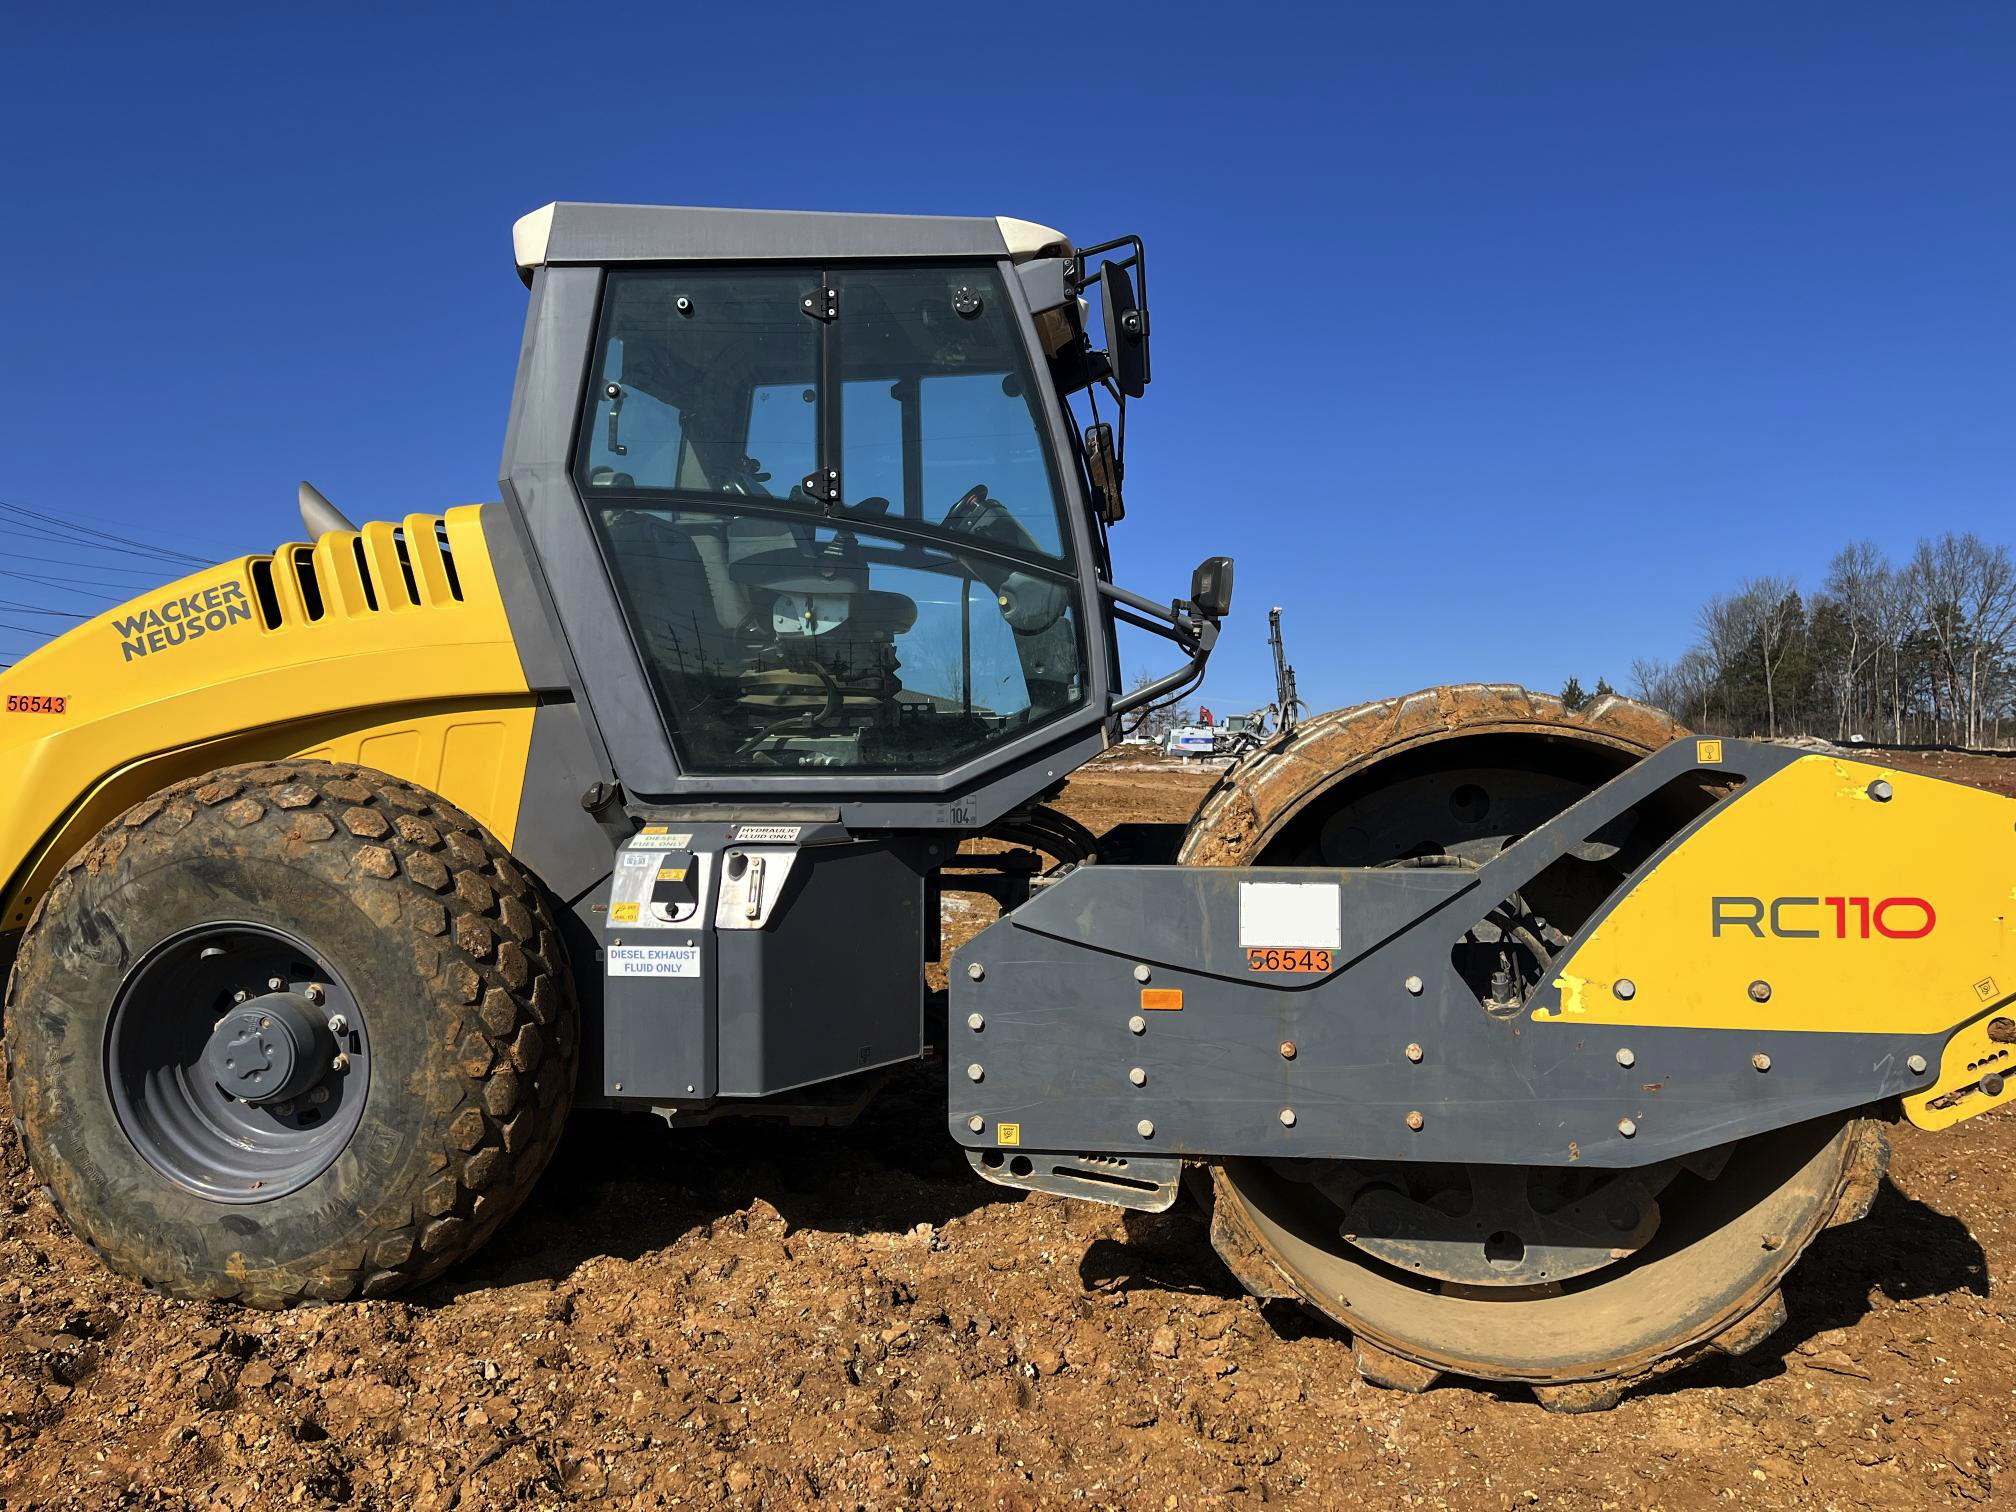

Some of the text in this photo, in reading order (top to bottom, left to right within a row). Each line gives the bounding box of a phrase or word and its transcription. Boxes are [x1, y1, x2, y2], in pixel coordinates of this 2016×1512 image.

[112, 580, 247, 639] WACKER
[120, 599, 252, 662] NEUSON
[7, 695, 65, 714] 56543
[951, 807, 969, 824] 104
[1711, 896, 1937, 939] RC110
[610, 950, 697, 960] DIESEL EXHAUST
[1250, 950, 1330, 971] 56543
[624, 963, 683, 973] FLUID ONLY
